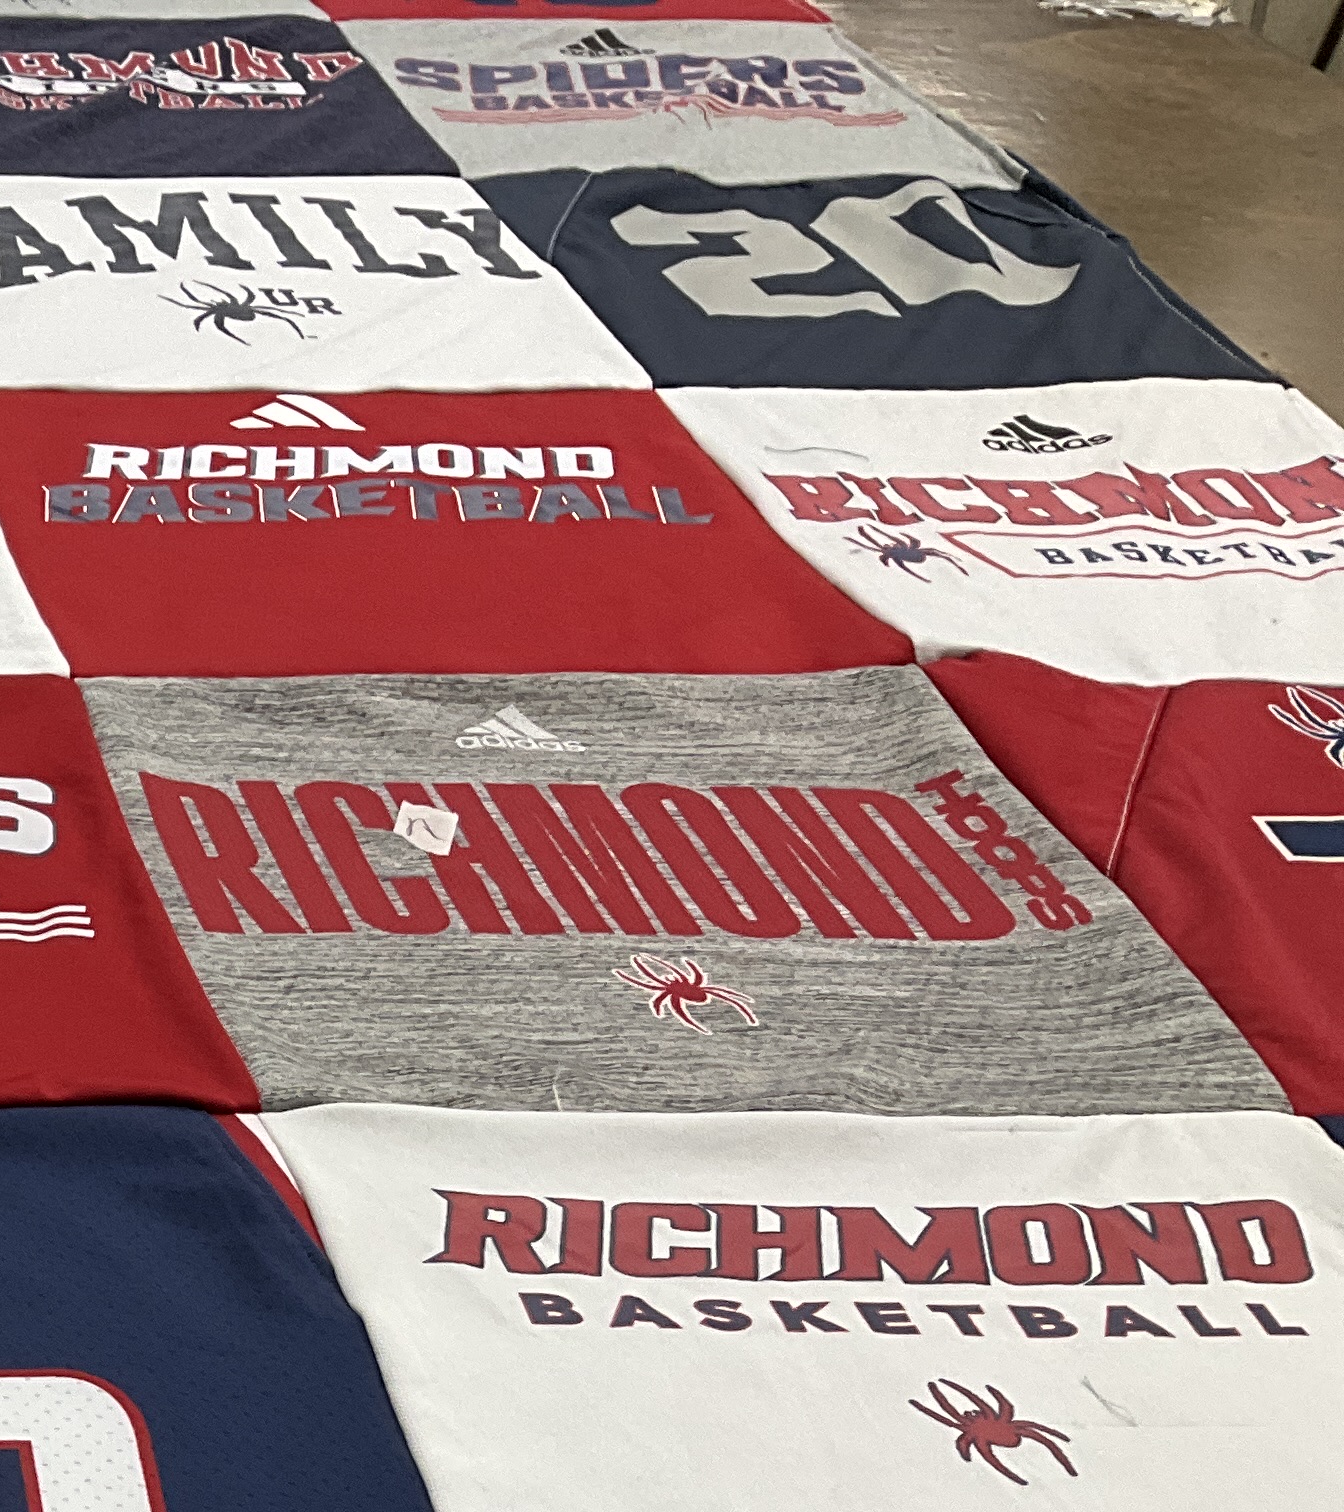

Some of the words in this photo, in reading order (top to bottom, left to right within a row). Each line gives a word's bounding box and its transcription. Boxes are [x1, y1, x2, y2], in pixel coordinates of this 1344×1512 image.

[609, 179, 1081, 317] 20
[258, 288, 343, 315] UR
[82, 443, 615, 480] RICHMOND
[981, 432, 1113, 454] adidas
[41, 478, 713, 524] BASKETBALL
[455, 733, 587, 752] adidas
[138, 770, 1017, 941] RICHMOND
[914, 769, 1093, 932] HOOPS
[421, 1188, 1315, 1287] RICHMOND
[517, 1292, 1312, 1339] BASKETBALL
